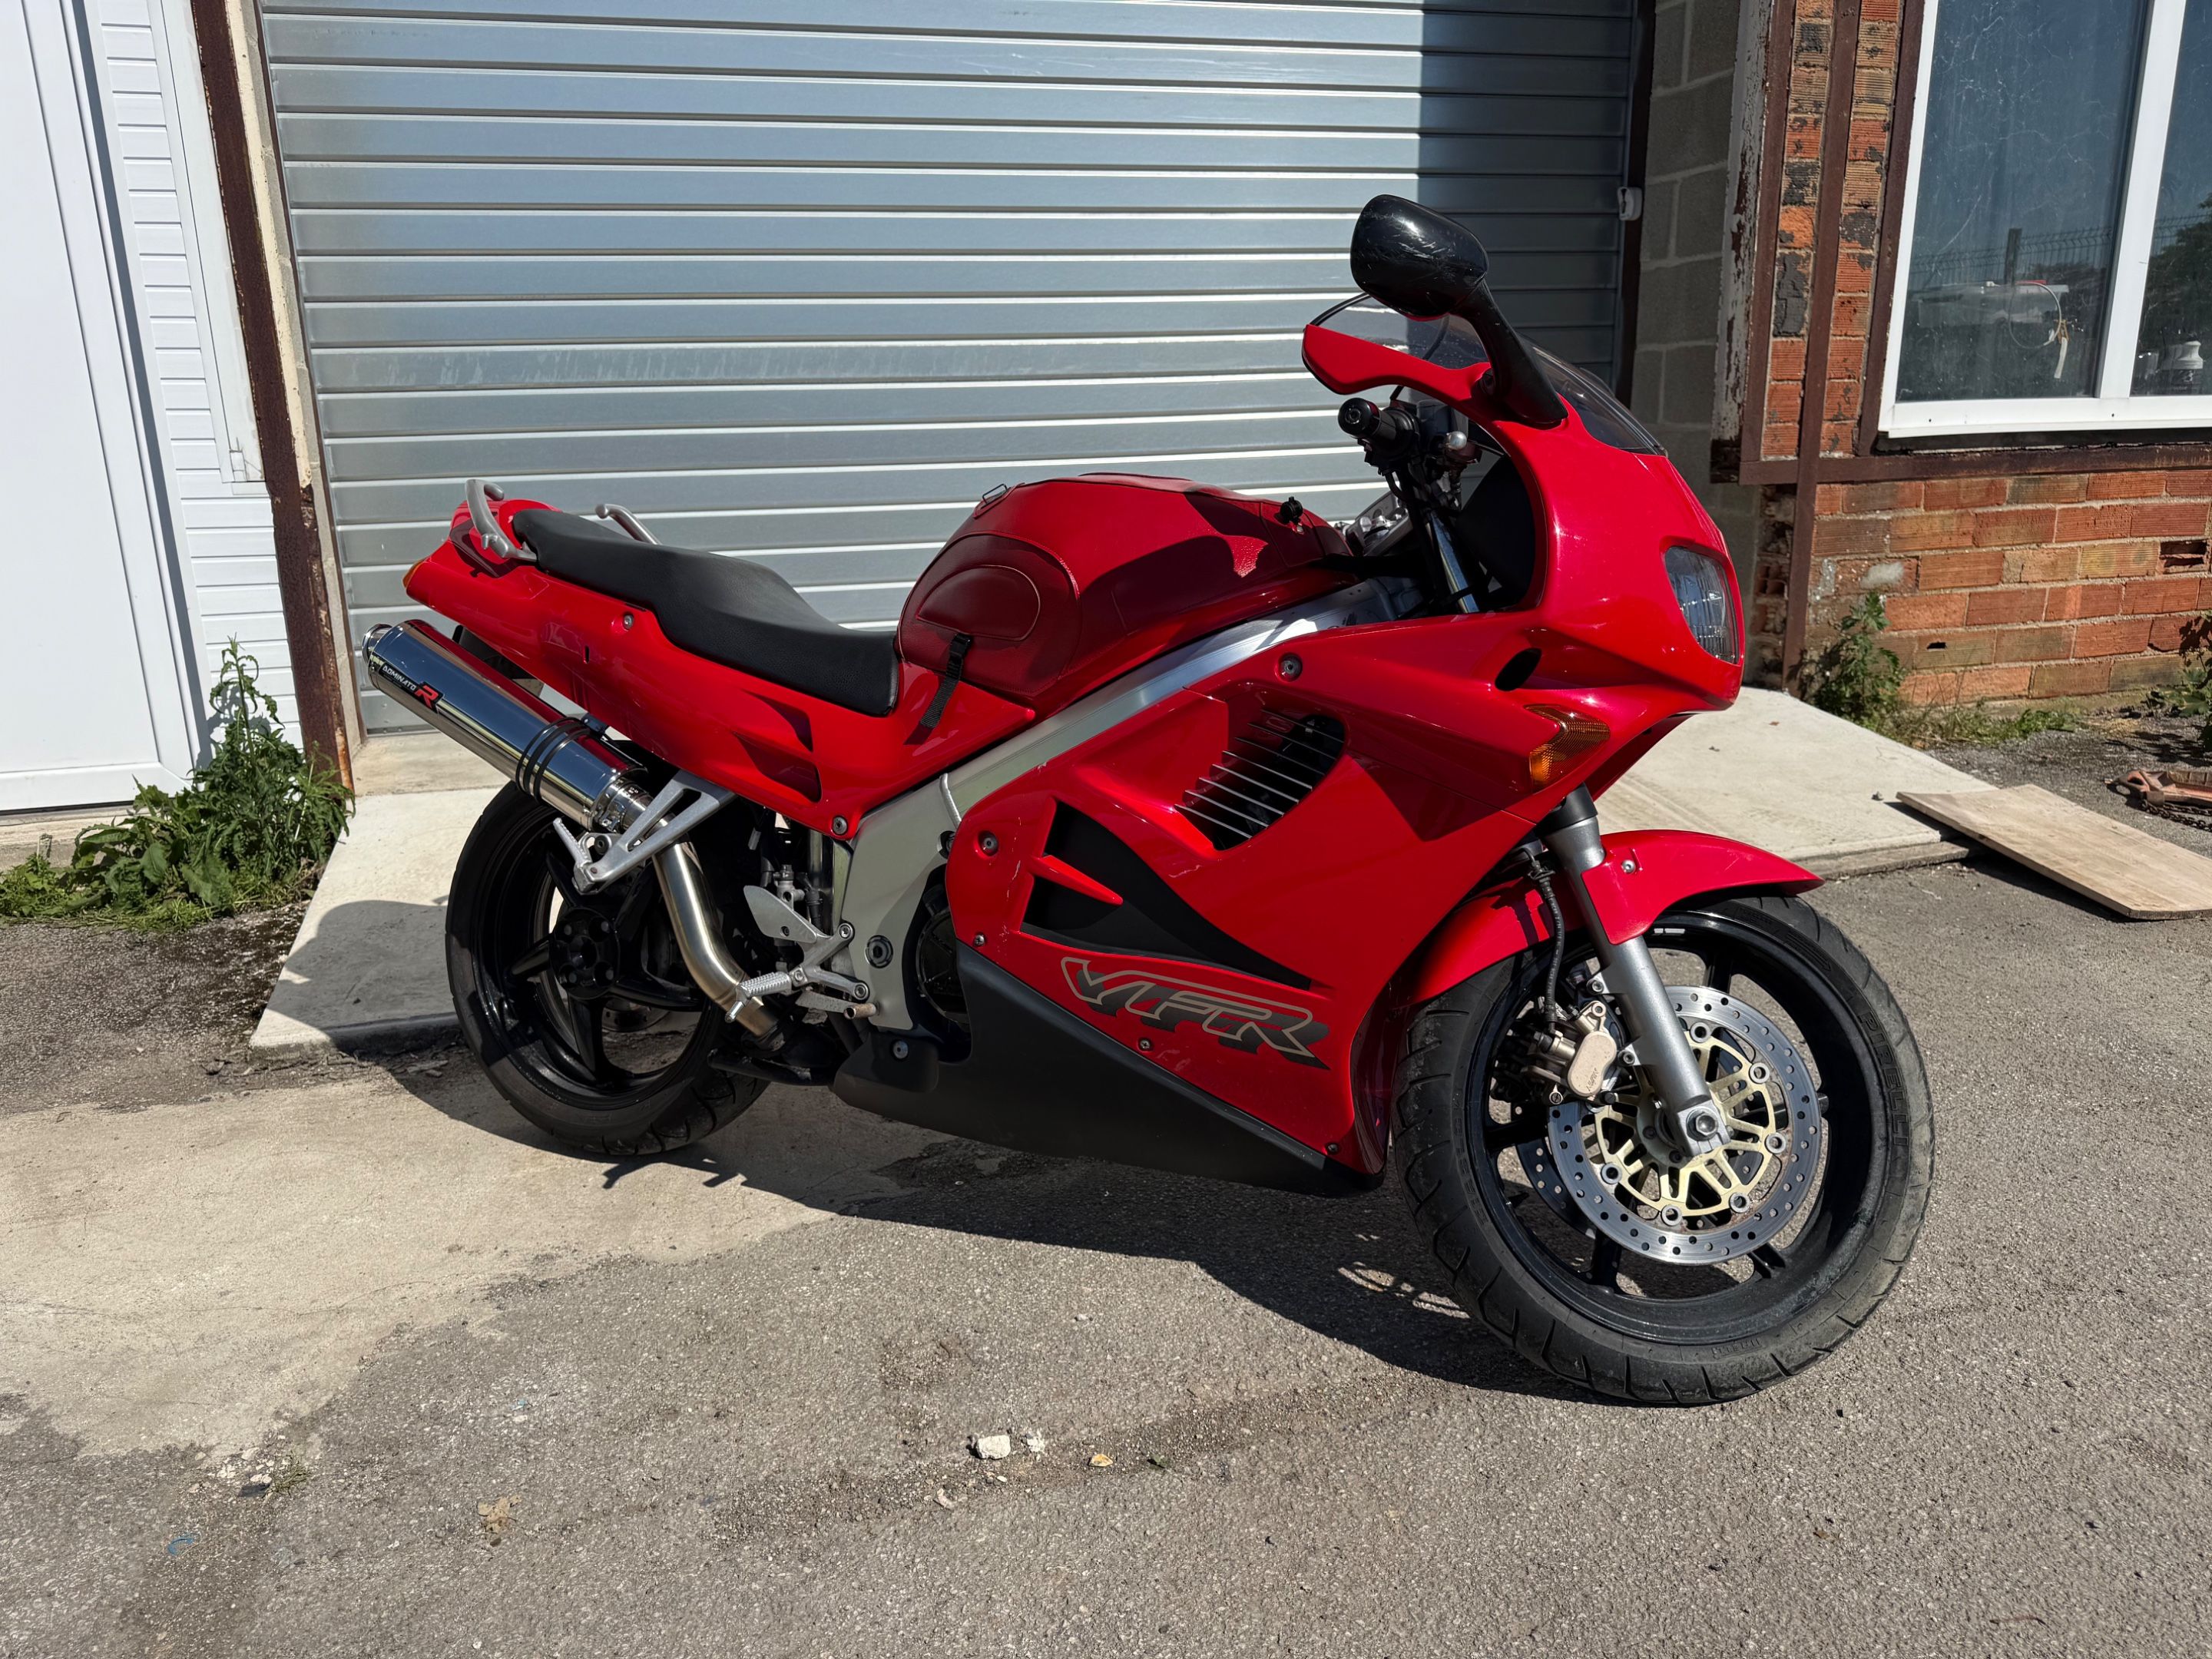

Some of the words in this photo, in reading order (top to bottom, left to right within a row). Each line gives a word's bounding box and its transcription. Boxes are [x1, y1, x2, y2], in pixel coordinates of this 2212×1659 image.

[382, 664, 439, 709] DOMINATOR
[1061, 956, 1331, 1070] VFR
[1857, 1010, 1909, 1147] PIRELLI
